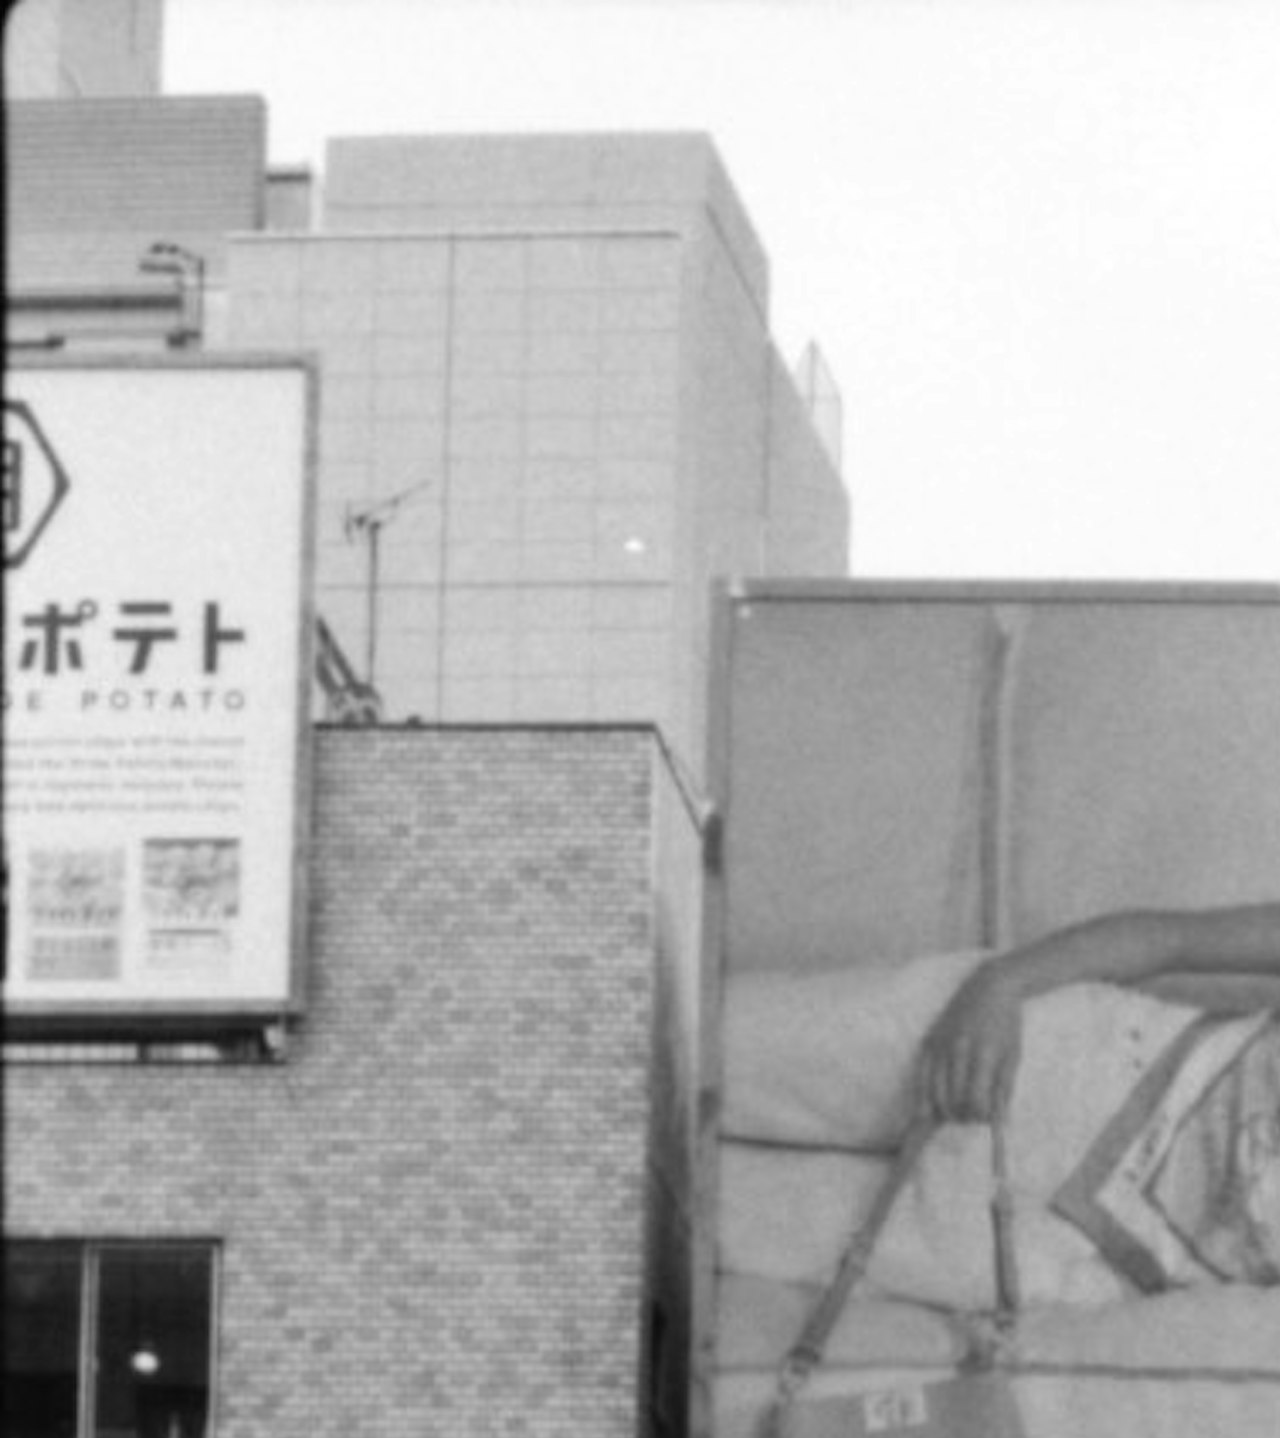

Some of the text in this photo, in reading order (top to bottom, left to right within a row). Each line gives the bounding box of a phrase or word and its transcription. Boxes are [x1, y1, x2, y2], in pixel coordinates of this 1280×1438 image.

[20, 600, 244, 676] ポテト
[81, 689, 245, 711] POTATO
